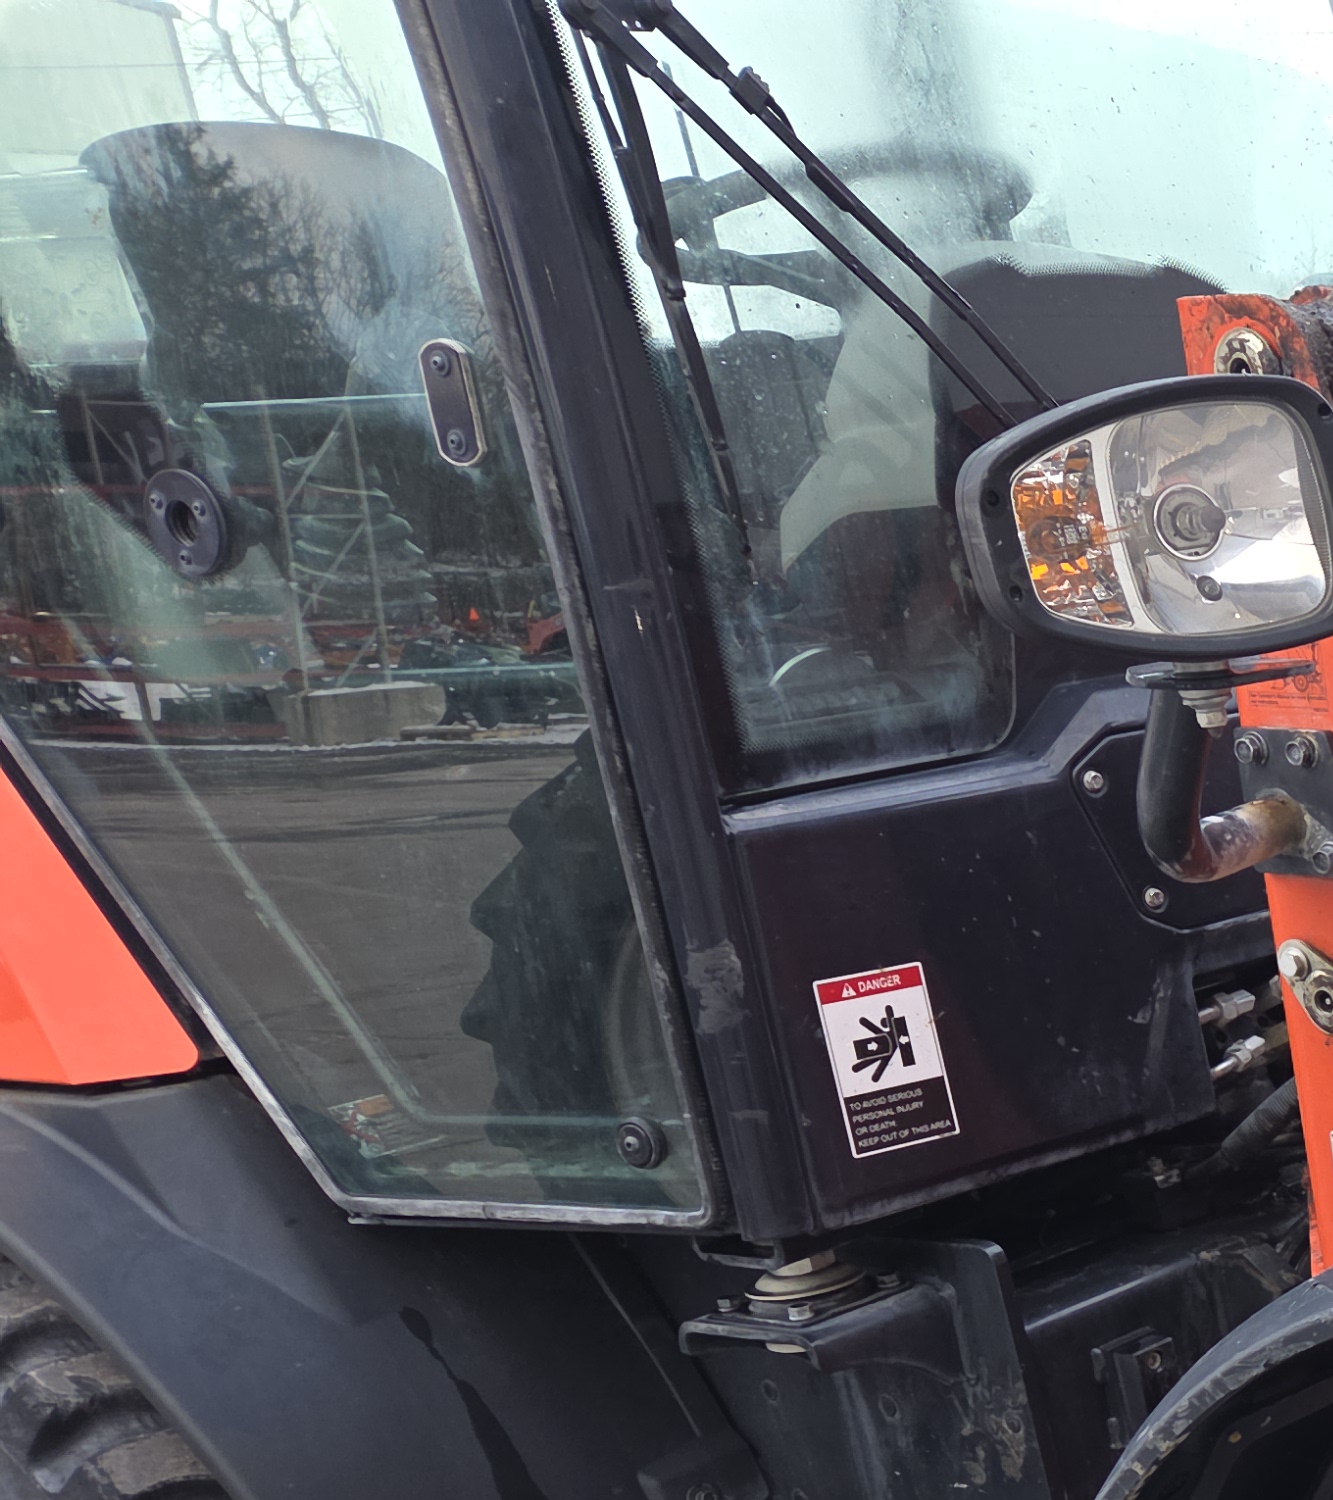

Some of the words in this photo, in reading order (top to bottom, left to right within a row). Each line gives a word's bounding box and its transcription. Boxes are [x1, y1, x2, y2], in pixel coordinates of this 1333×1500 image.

[858, 974, 901, 993] DANGER
[849, 1102, 861, 1111] TO
[862, 1096, 887, 1108] AVOID
[887, 1088, 923, 1103] SERIOUS
[852, 1108, 896, 1124] PERSONAL
[896, 1101, 923, 1113] INJURY
[855, 1126, 868, 1136] OR
[858, 1136, 879, 1147] KEEP
[880, 1131, 897, 1142] OUT
[898, 1128, 909, 1138] OF
[911, 1124, 929, 1135] THIS
[930, 1119, 951, 1130] AREA
